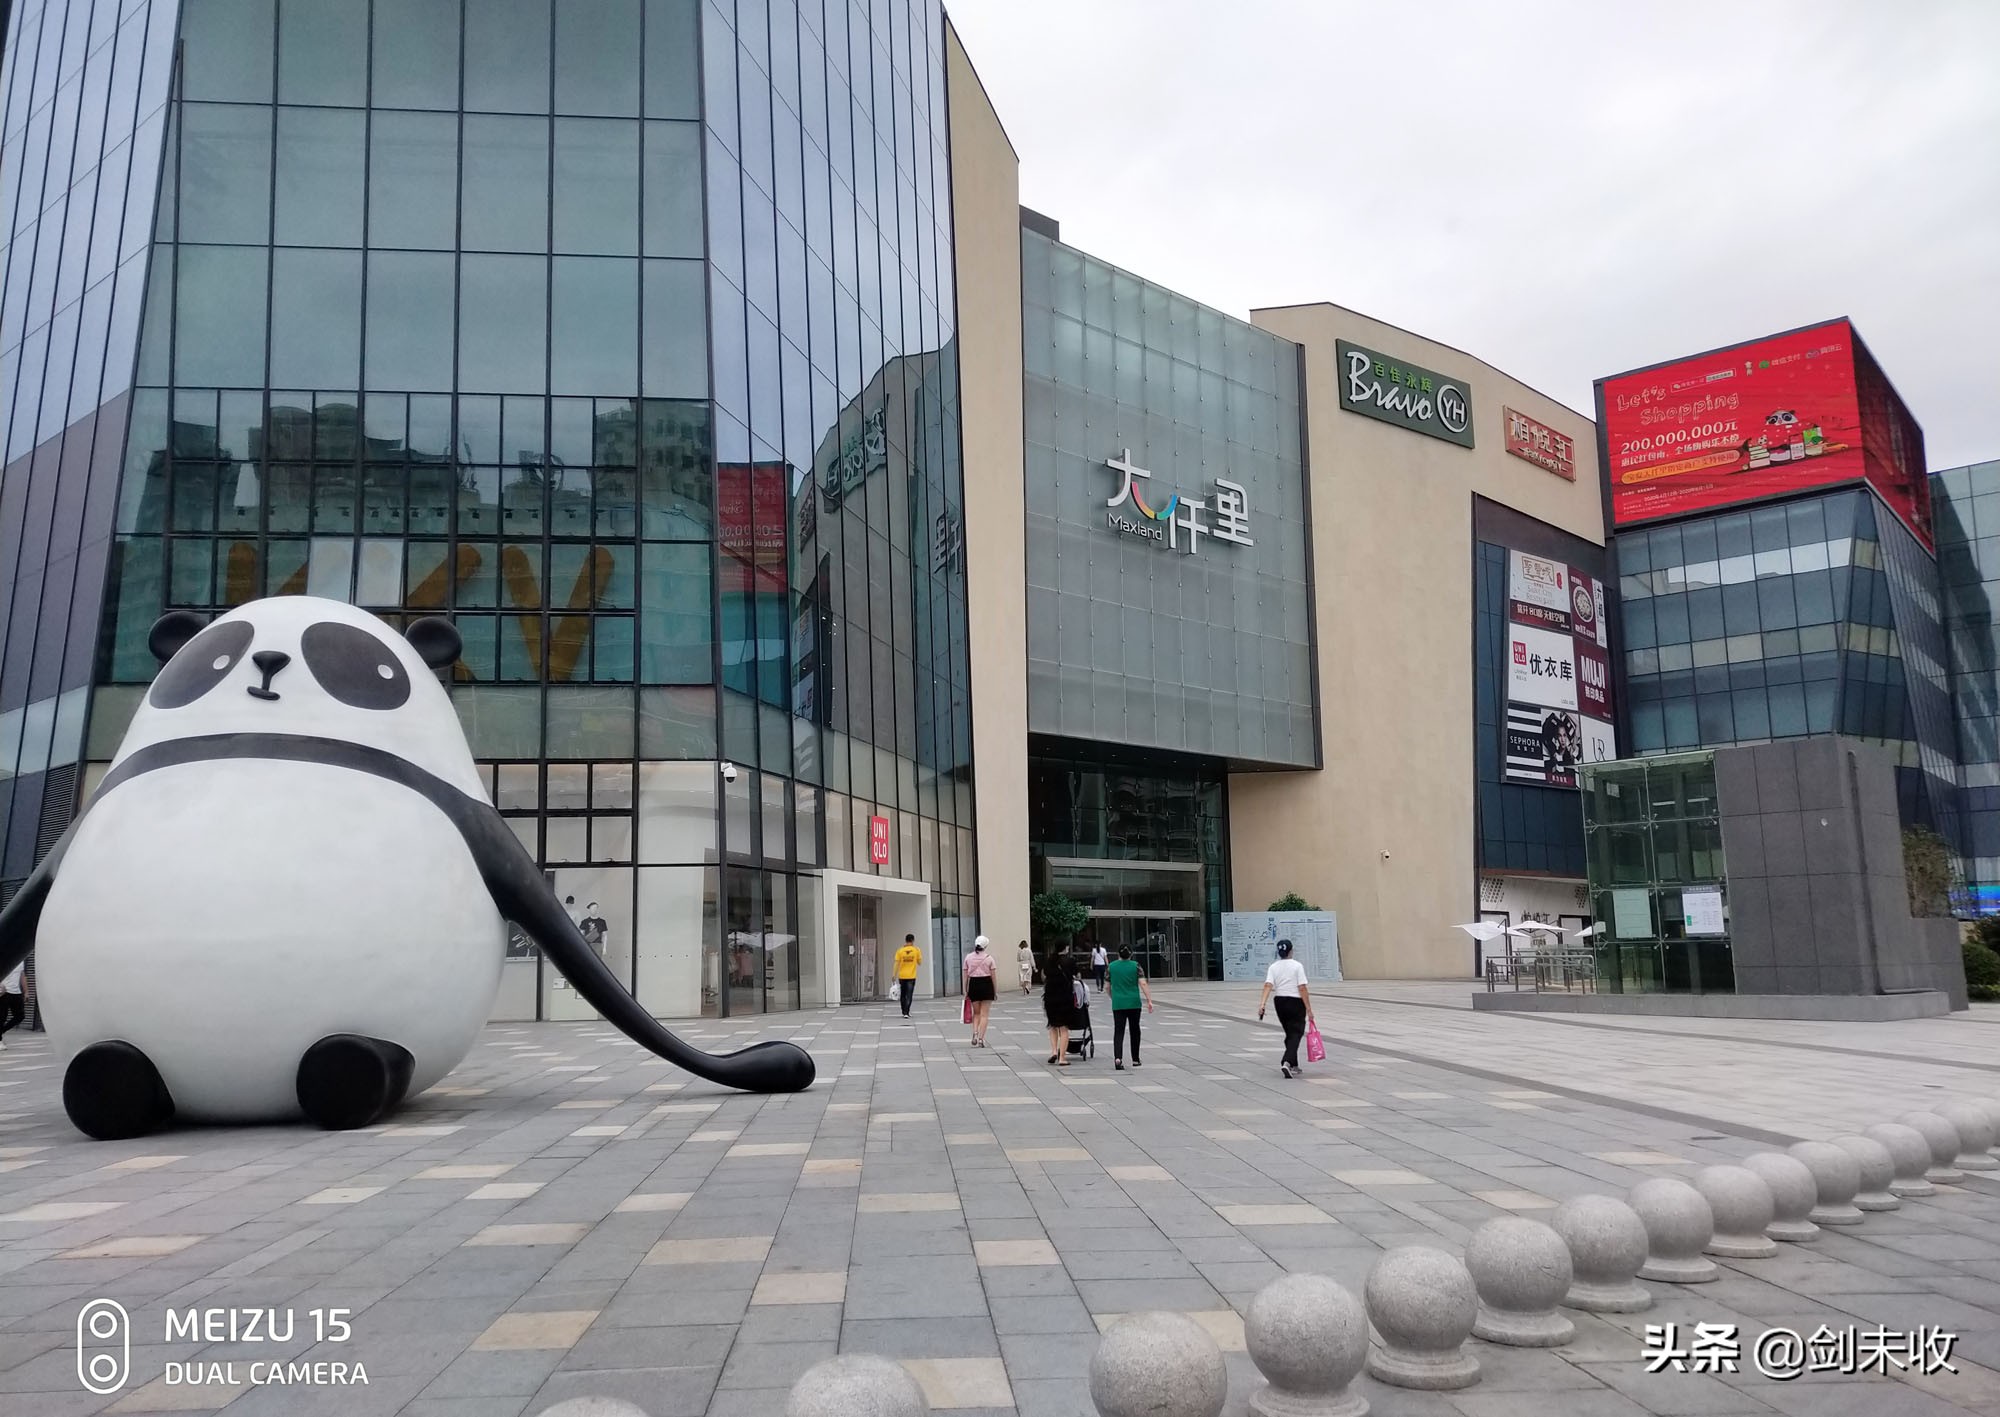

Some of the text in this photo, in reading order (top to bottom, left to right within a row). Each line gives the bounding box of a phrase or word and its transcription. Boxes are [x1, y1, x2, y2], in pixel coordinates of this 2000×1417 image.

[1346, 351, 1466, 423] Bravo YH
[1373, 361, 1434, 394] 百佳永辉
[1616, 384, 1667, 412] Let's
[1640, 392, 1740, 426] Shopping
[1620, 419, 1739, 455] 200,000,000元
[1105, 448, 1254, 554] 大仟里
[1107, 513, 1163, 541] Maxland
[1514, 642, 1525, 653] UNI
[1515, 652, 1526, 663] QLO
[1529, 653, 1573, 682] 优衣库
[1580, 655, 1606, 689] MUJI
[1510, 735, 1541, 748] SEPHORA
[873, 821, 886, 840] UNI
[873, 841, 887, 860] QLO
